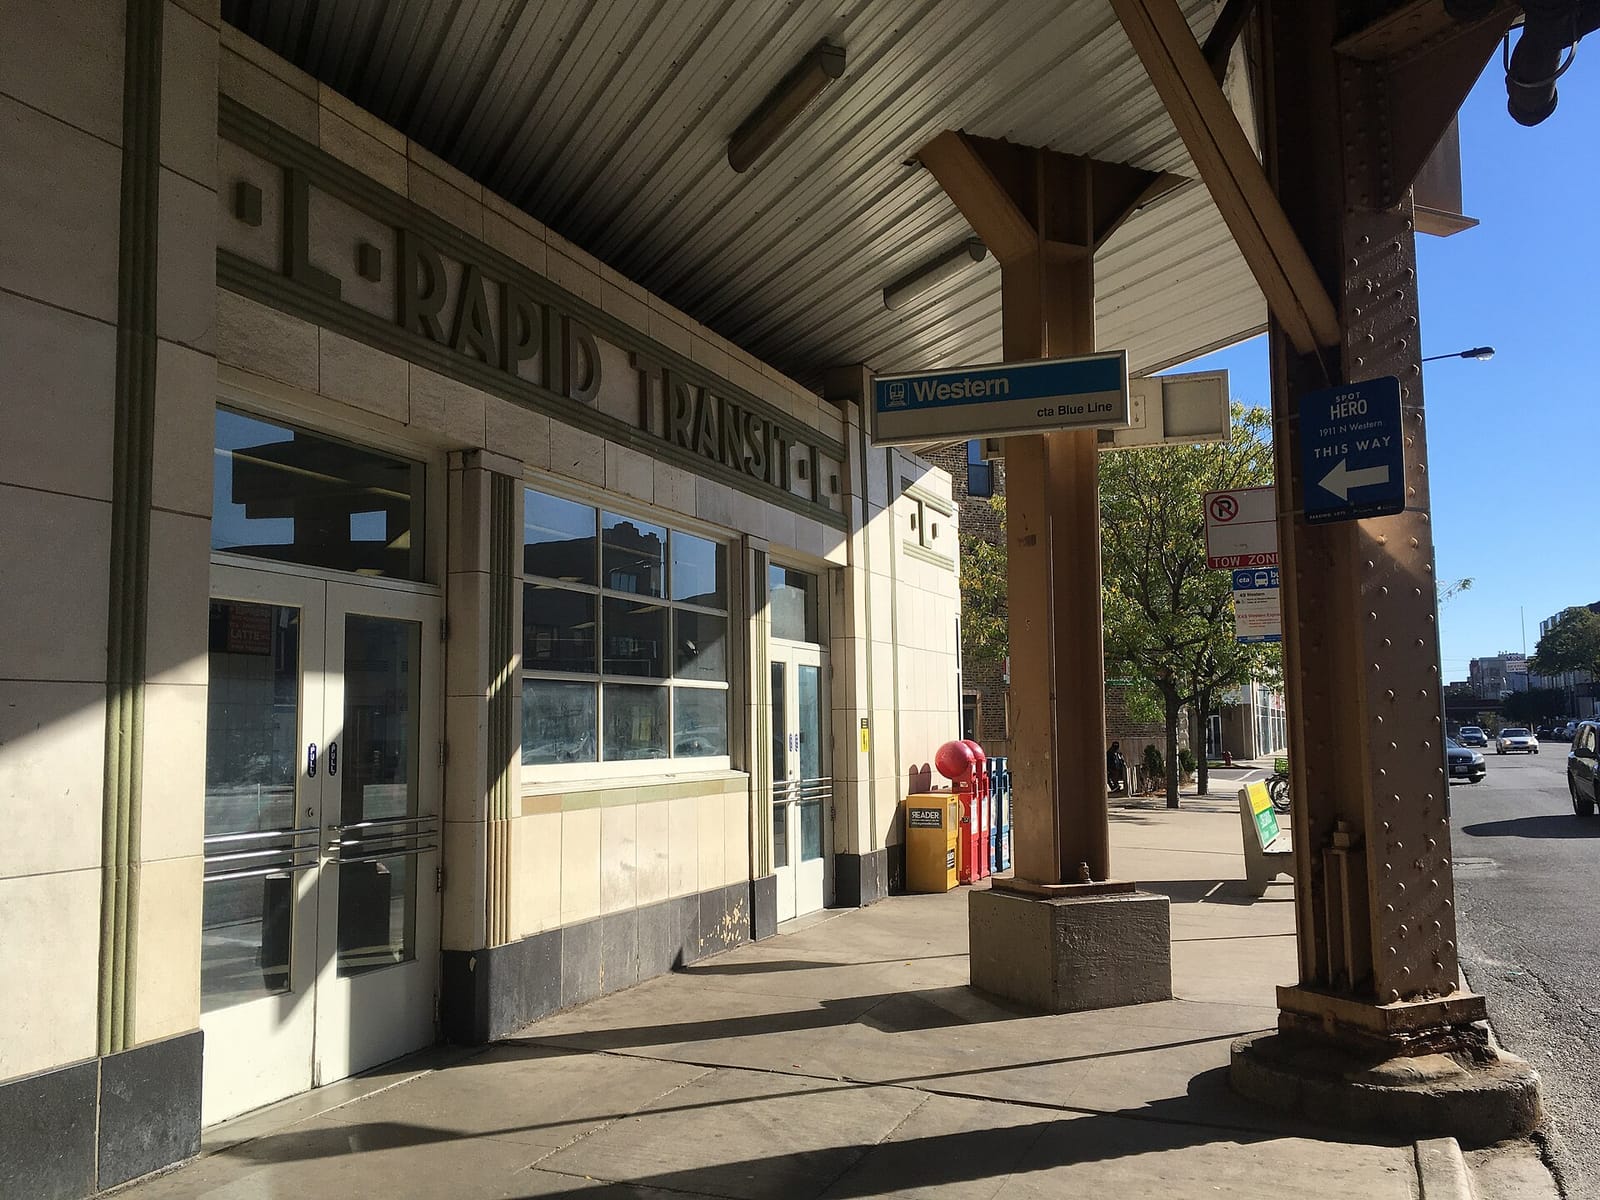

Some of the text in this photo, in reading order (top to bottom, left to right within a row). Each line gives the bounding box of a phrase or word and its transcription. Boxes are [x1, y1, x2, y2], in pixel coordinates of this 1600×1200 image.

[396, 228, 602, 403] RAPID
[628, 351, 799, 494] TRANSIT
[913, 376, 1010, 402] Western
[1336, 391, 1361, 403] SPOT
[1037, 401, 1113, 418] cta Blue Line
[1330, 399, 1368, 420] HERO
[1320, 420, 1383, 438] 1911 N Western
[1314, 436, 1391, 458] THIS WAY
[1213, 555, 1240, 567] TOW
[911, 811, 940, 819] READER
